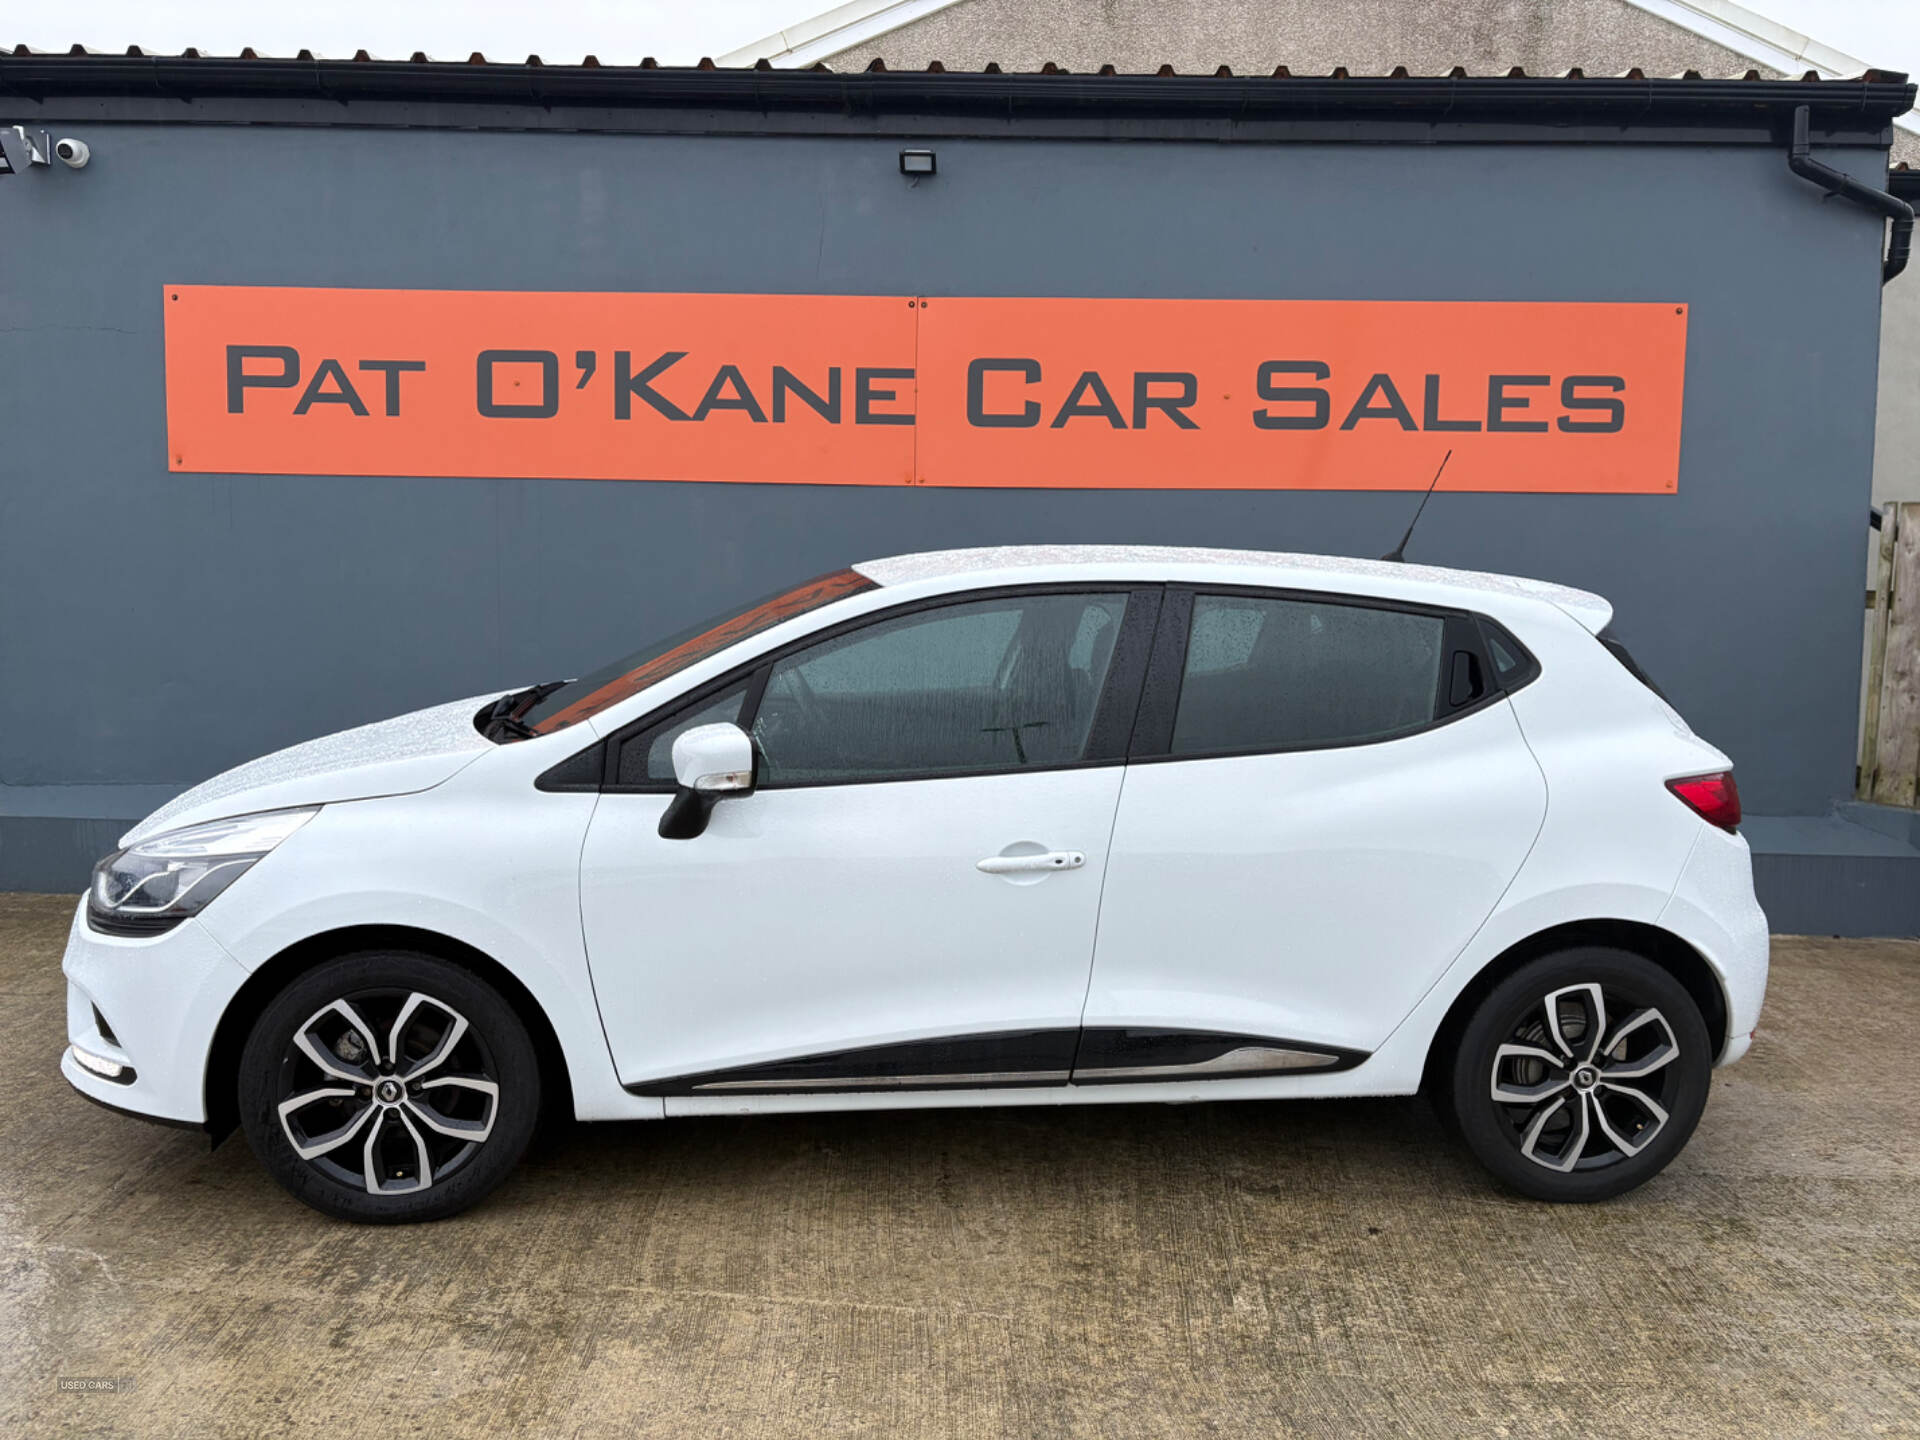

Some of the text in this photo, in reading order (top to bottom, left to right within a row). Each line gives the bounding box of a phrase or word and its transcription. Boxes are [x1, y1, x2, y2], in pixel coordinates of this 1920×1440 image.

[226, 345, 1626, 434] PAT O'KANE CAR SALES
